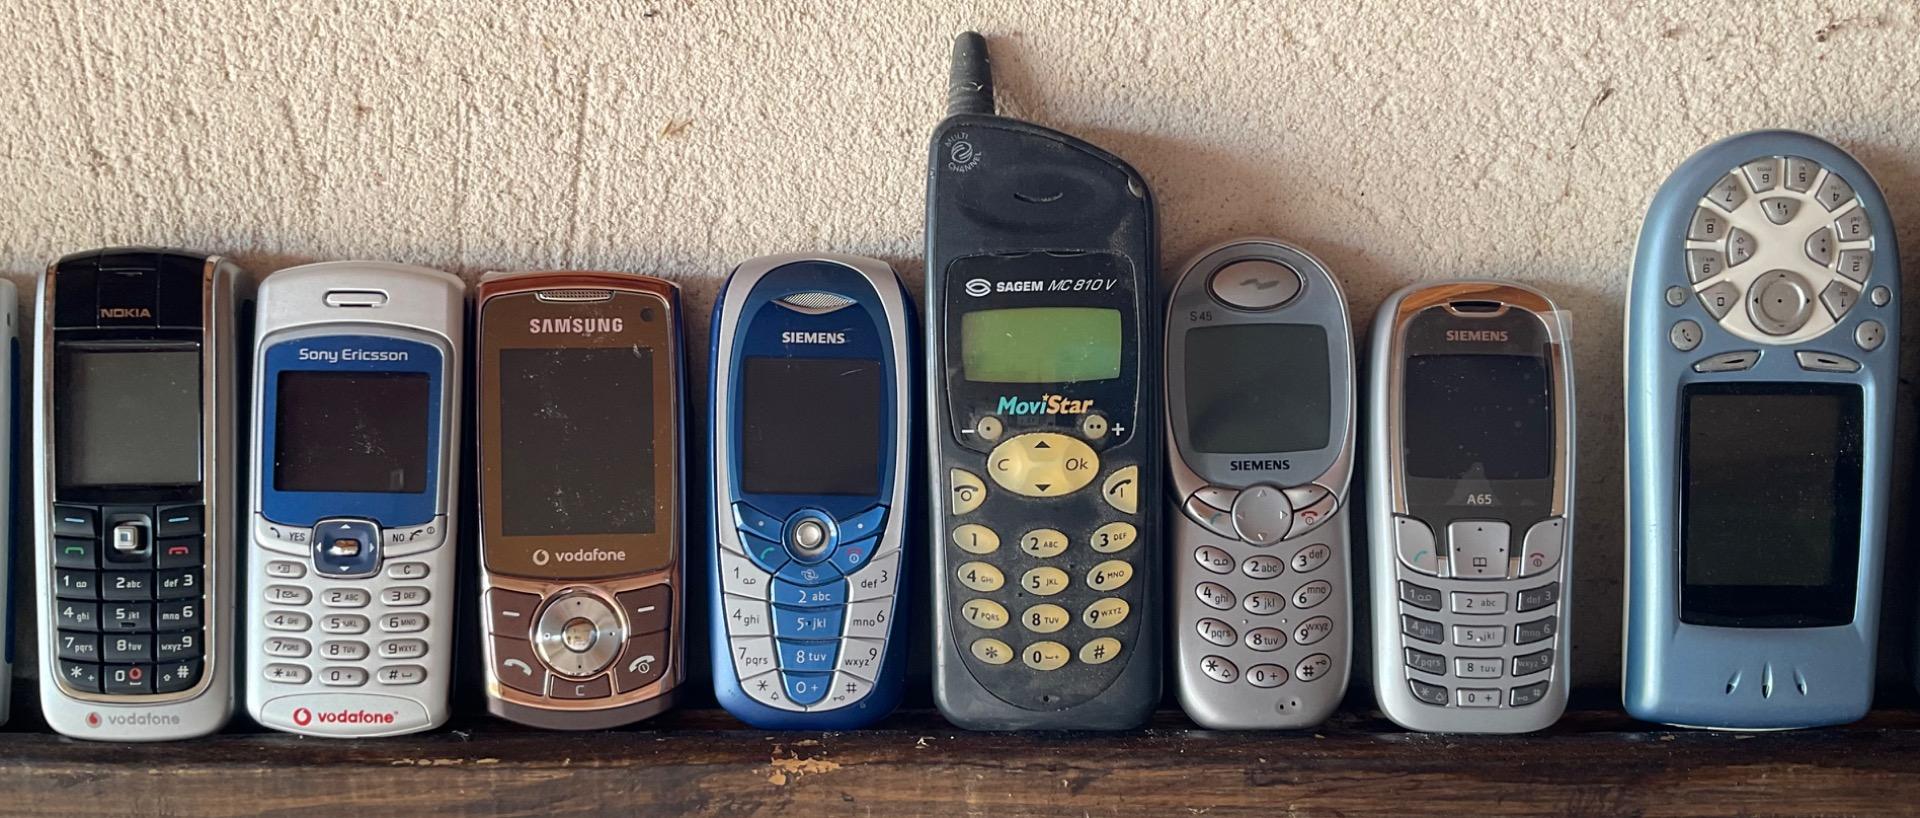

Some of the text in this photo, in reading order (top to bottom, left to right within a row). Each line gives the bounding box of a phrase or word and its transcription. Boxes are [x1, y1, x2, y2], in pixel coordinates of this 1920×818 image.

[945, 132, 968, 147] MULTI
[948, 152, 982, 173] CHANNEL
[1706, 224, 1713, 233] 8
[1852, 225, 1859, 234] 3
[997, 279, 1117, 292] SAGEM MC 810 V
[101, 308, 151, 318] NOKIA
[529, 318, 623, 333] SAMSUNG
[782, 332, 845, 344] SIEMENS
[1446, 330, 1508, 342] SIEMENS
[299, 349, 408, 363] Sony Ericsson
[996, 393, 1093, 415] MoviStar
[998, 458, 1009, 471] C
[1065, 458, 1088, 470] Ok
[1230, 460, 1290, 471] SIEMENS
[1467, 494, 1492, 505] A65
[289, 532, 305, 542] YES
[393, 534, 404, 542] NO
[972, 533, 977, 546] 1
[1100, 533, 1127, 547] 3 DEF
[1031, 538, 1039, 550] 2
[555, 548, 626, 562] vodafone
[1203, 551, 1209, 562] 1
[1300, 550, 1323, 566] 3 def
[404, 565, 410, 574] C
[734, 567, 739, 578] 1
[1251, 561, 1277, 573] 2 abc
[64, 576, 69, 586] 1
[164, 575, 193, 587] def 3
[861, 570, 888, 588] def 3
[967, 570, 976, 582] 4
[1096, 571, 1104, 584] 6
[116, 578, 125, 588] 2
[1032, 576, 1040, 589] 5
[275, 589, 280, 599] 1
[332, 593, 341, 602] 2
[392, 591, 401, 601] 3
[799, 590, 831, 603] 2 abc
[1203, 587, 1229, 605] 4 ghi
[1299, 592, 1307, 603] 6
[1252, 597, 1275, 610] 5 jkl
[1466, 599, 1496, 608] 2 abc
[63, 607, 89, 622] 4 ghi
[116, 609, 125, 619] 5
[183, 606, 193, 618] 6
[733, 609, 760, 626] 4 ghi
[877, 610, 885, 622] 6
[970, 607, 999, 621] 7 PQRS
[1091, 608, 1122, 623] 9 WXYZ
[274, 616, 283, 625] 4
[331, 619, 340, 628] 5
[390, 617, 399, 628] 6
[797, 618, 826, 631] 5 jkl
[1032, 613, 1040, 626] 8
[1204, 622, 1230, 639] 7 pqrs
[1300, 623, 1329, 639] 9 wxyz
[1467, 631, 1473, 640] 5
[65, 638, 93, 653] 7 pqrs
[117, 640, 126, 650] 8
[161, 636, 192, 652] wxyz 9
[1253, 634, 1278, 645] 8 tuv
[273, 641, 282, 652] 7
[330, 645, 339, 655] 8
[388, 643, 397, 654] 9
[738, 647, 768, 666] 7 pqrs
[796, 650, 827, 663] 8 tuv
[845, 648, 877, 666] wxyz 9
[1033, 651, 1042, 663] 0
[1541, 656, 1548, 664] 9
[1467, 663, 1474, 671] 8
[1256, 671, 1264, 681] 0
[576, 685, 584, 696] C
[796, 682, 804, 693] 0
[108, 713, 180, 725] vodafone
[318, 710, 394, 724] vodafone
